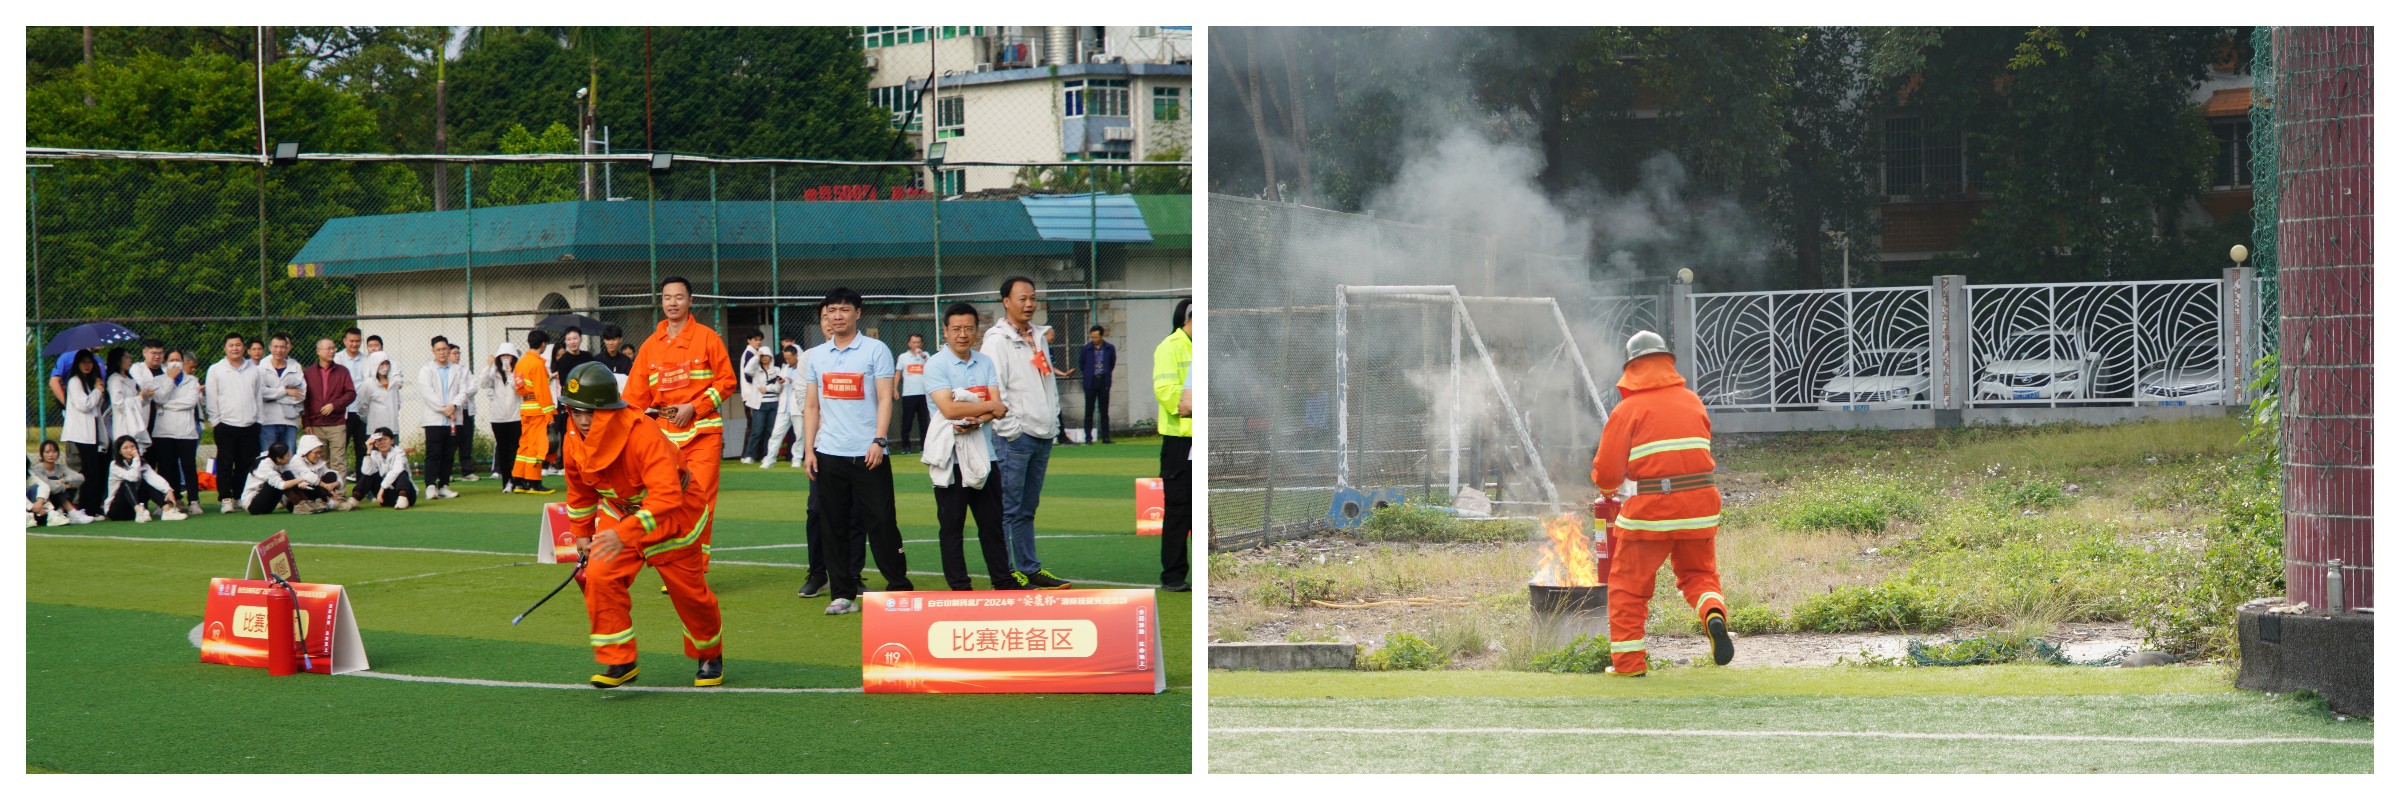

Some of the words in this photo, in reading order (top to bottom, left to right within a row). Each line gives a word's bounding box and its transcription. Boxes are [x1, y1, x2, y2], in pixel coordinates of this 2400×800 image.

[243, 611, 268, 633] 比赛
[952, 627, 1074, 652] 比赛准备区
[884, 651, 901, 665] 119
